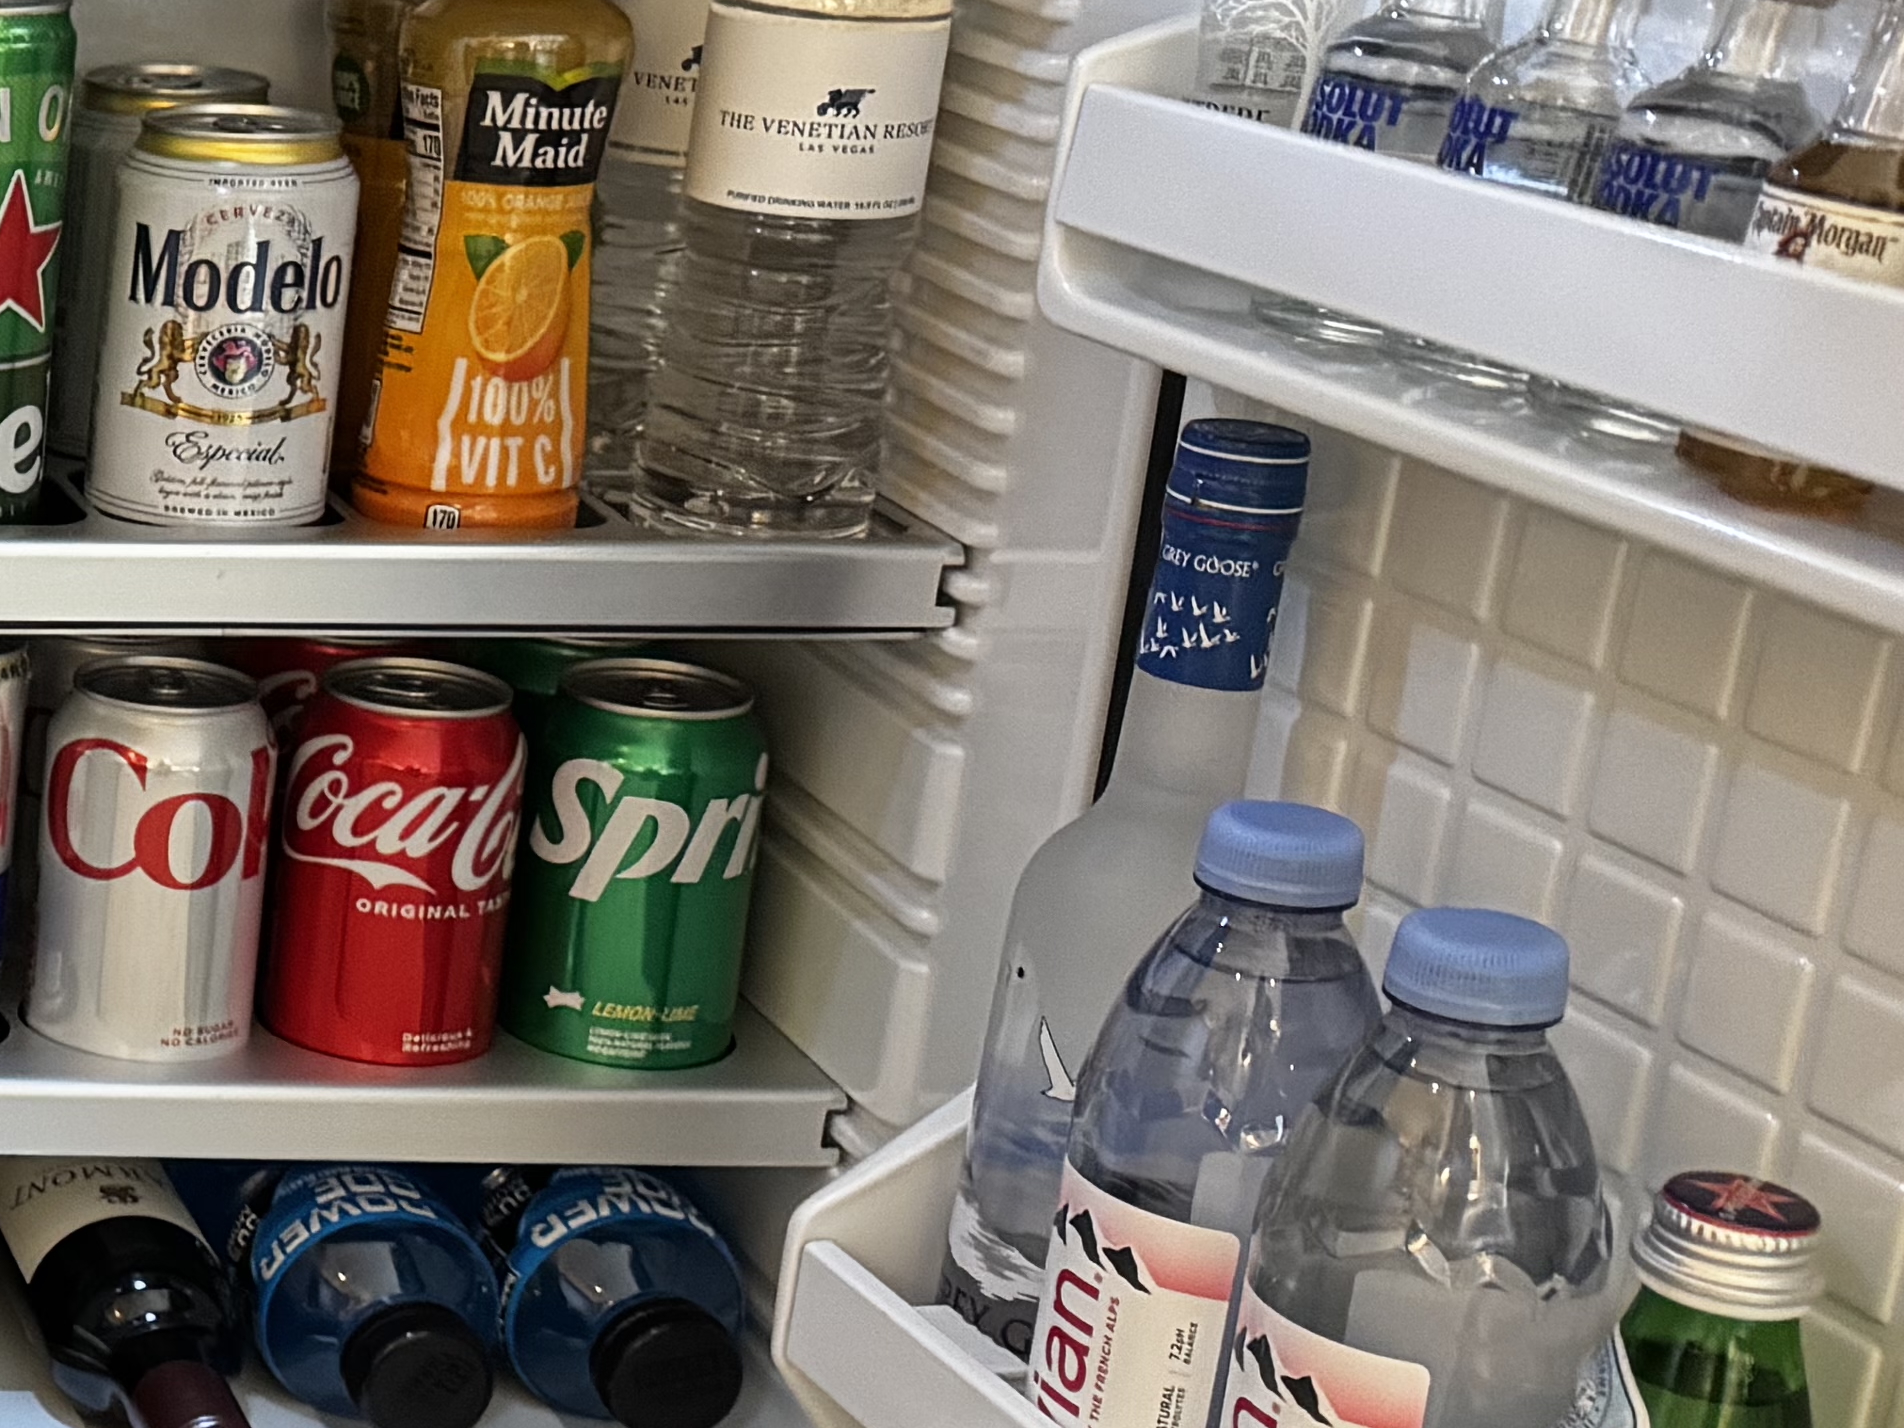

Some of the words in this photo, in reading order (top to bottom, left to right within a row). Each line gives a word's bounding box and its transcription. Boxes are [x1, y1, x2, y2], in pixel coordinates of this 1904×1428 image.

[480, 90, 607, 130] Minute
[719, 110, 755, 131] THE
[762, 117, 878, 141] VENETIAN
[491, 131, 588, 168] Maid
[799, 142, 824, 153] LAS
[833, 143, 875, 155] VEGAS
[1803, 210, 1888, 264] Morgan
[129, 222, 343, 314] Modelo
[467, 374, 556, 427] 100%
[165, 430, 288, 471] Especial
[460, 435, 524, 487] VIT
[534, 435, 556, 486] C
[1162, 544, 1191, 568] GREY
[1193, 554, 1252, 578] GOOSE
[355, 898, 471, 919] ORIGINAL
[160, 1037, 181, 1047] NO
[173, 1025, 192, 1038] NO
[402, 1031, 463, 1044] Delicious
[1106, 1297, 1121, 1333] ALPS
[1094, 1336, 1113, 1392] FRENCH
[1089, 1394, 1104, 1422] THE
